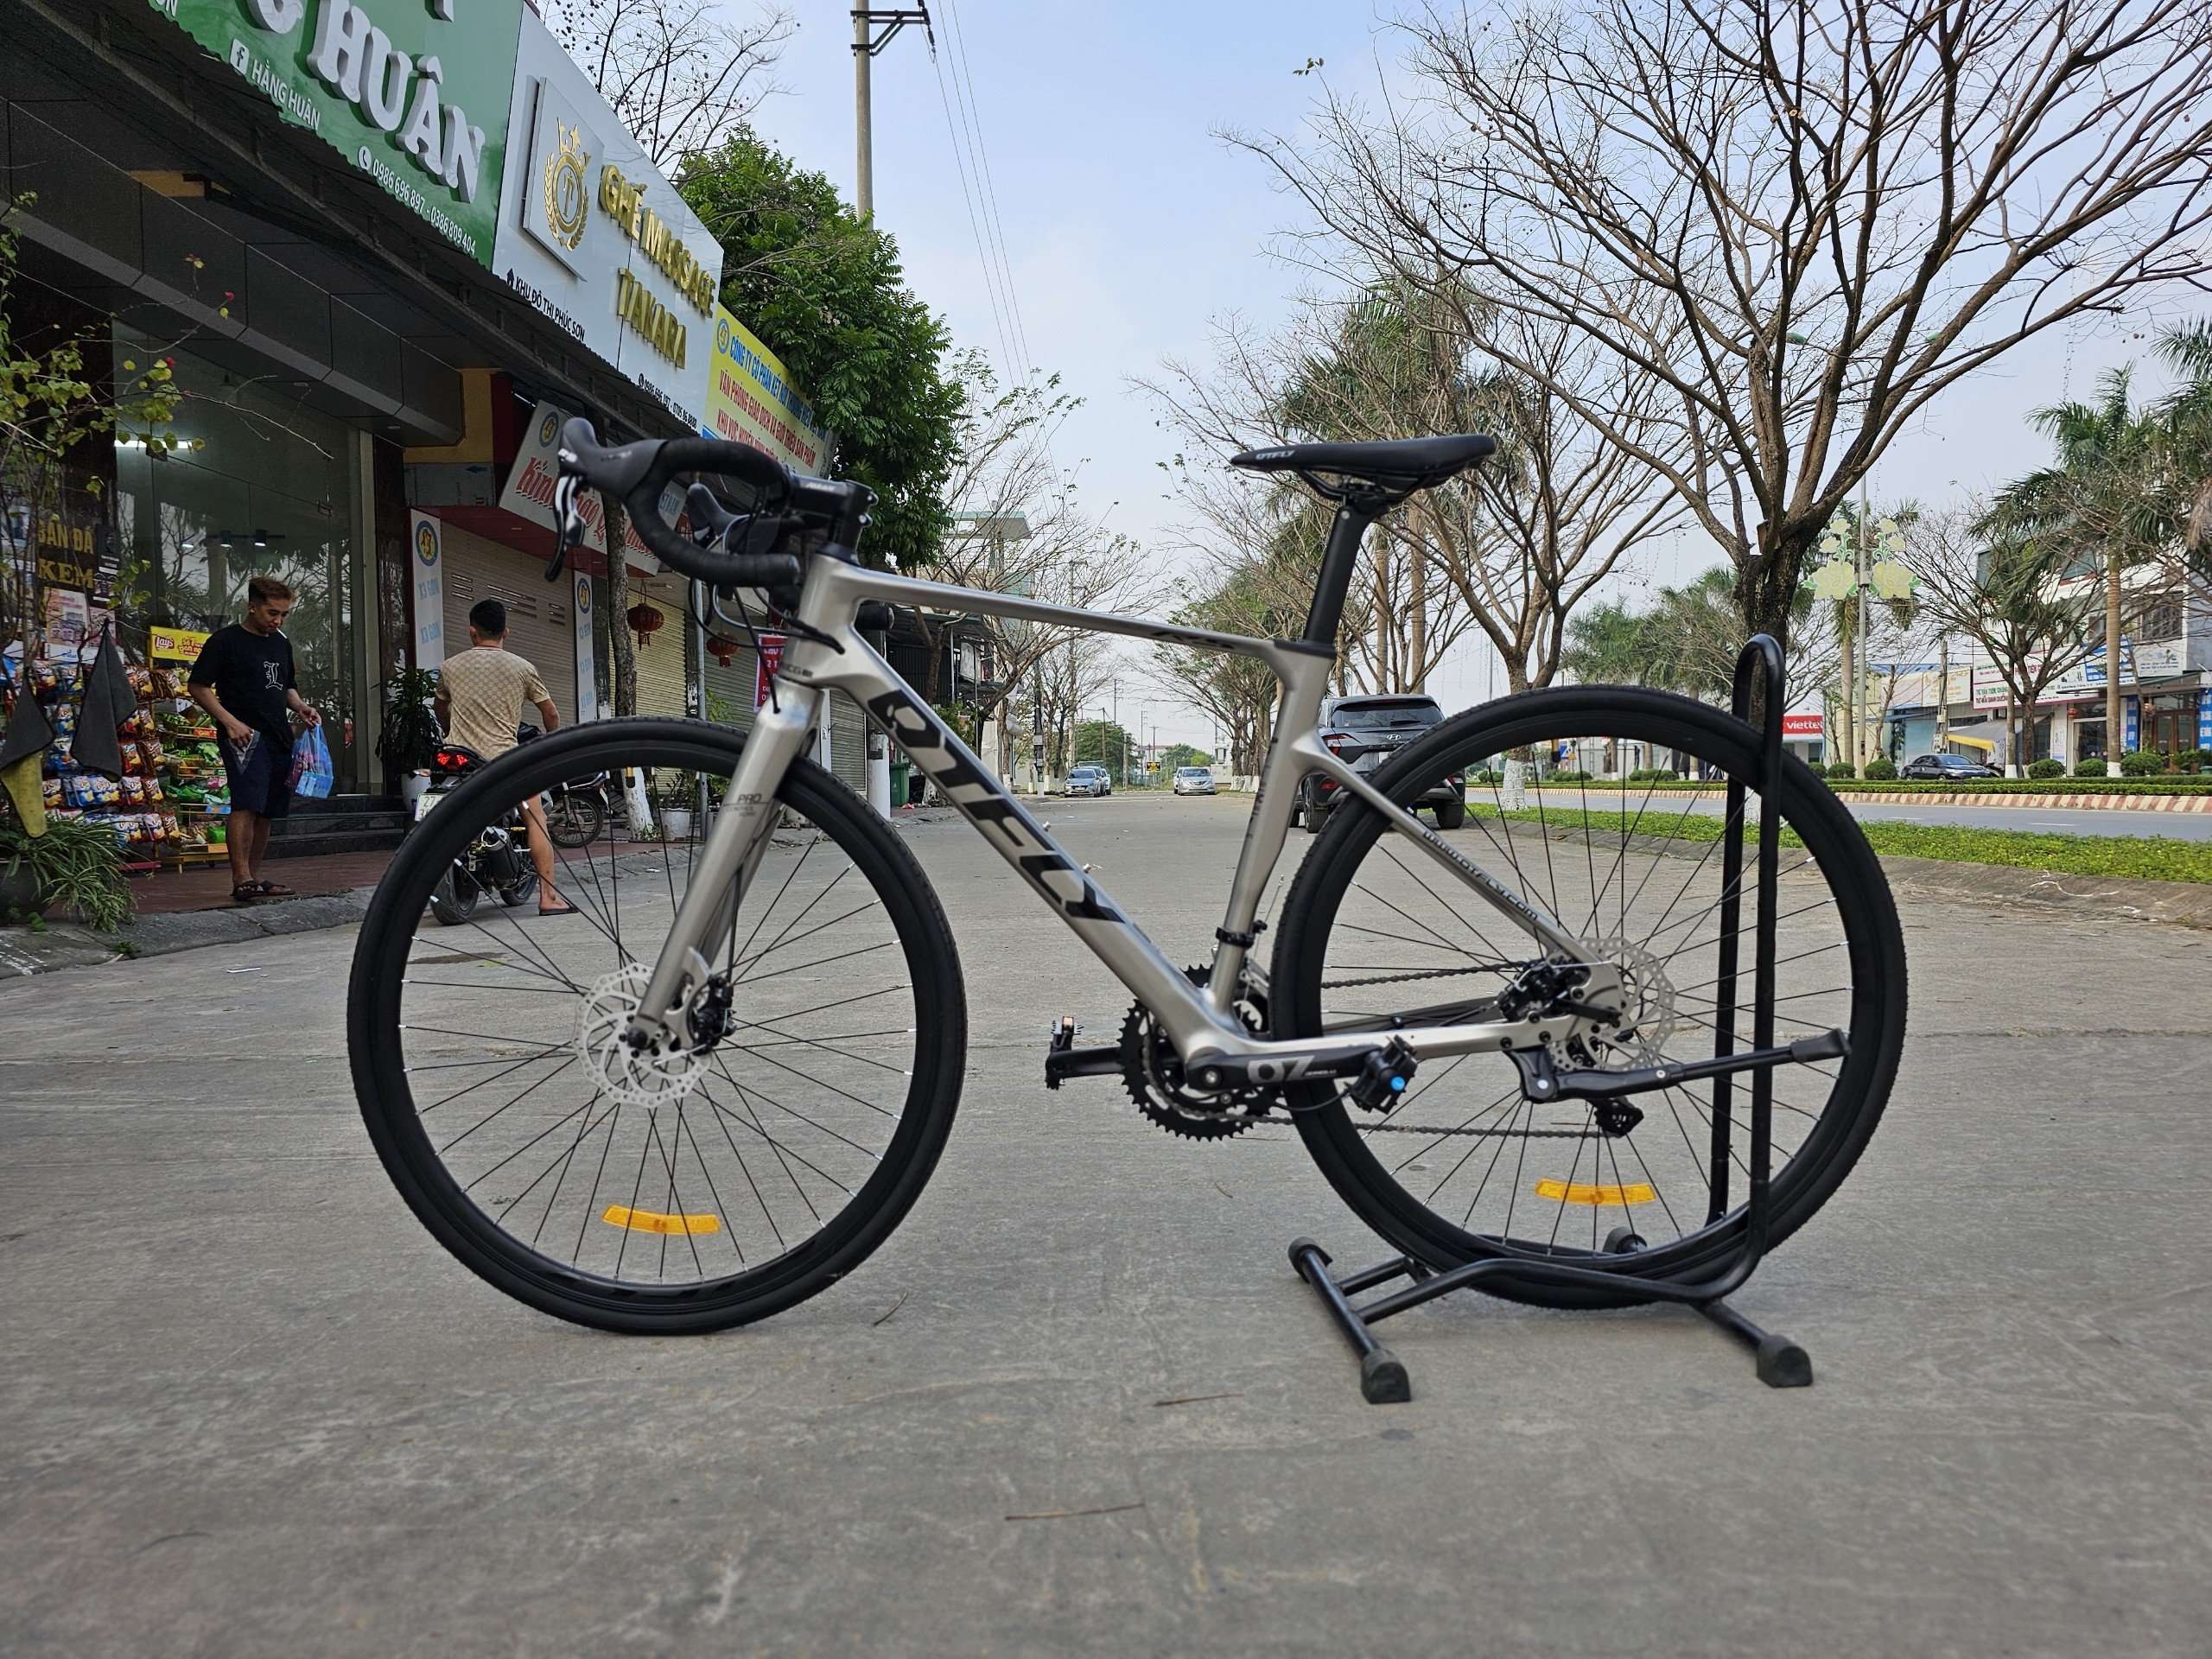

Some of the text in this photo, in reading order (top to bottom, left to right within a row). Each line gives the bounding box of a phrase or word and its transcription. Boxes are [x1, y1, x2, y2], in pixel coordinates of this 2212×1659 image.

[288, 88, 321, 130] HUÂN
[307, 0, 486, 204] HUÂN
[372, 158, 394, 188] 0986
[394, 176, 410, 203] 696
[410, 189, 425, 213] 897
[431, 206, 448, 232] 0386
[448, 220, 462, 245] 809
[462, 232, 476, 255] 404
[598, 164, 716, 319] GHẾ MASSAGE
[515, 276, 531, 299] KHU
[555, 307, 571, 331] PHÚC
[571, 321, 585, 341] SƠN
[616, 267, 686, 370] TAKARA
[737, 793, 762, 804] PRO
